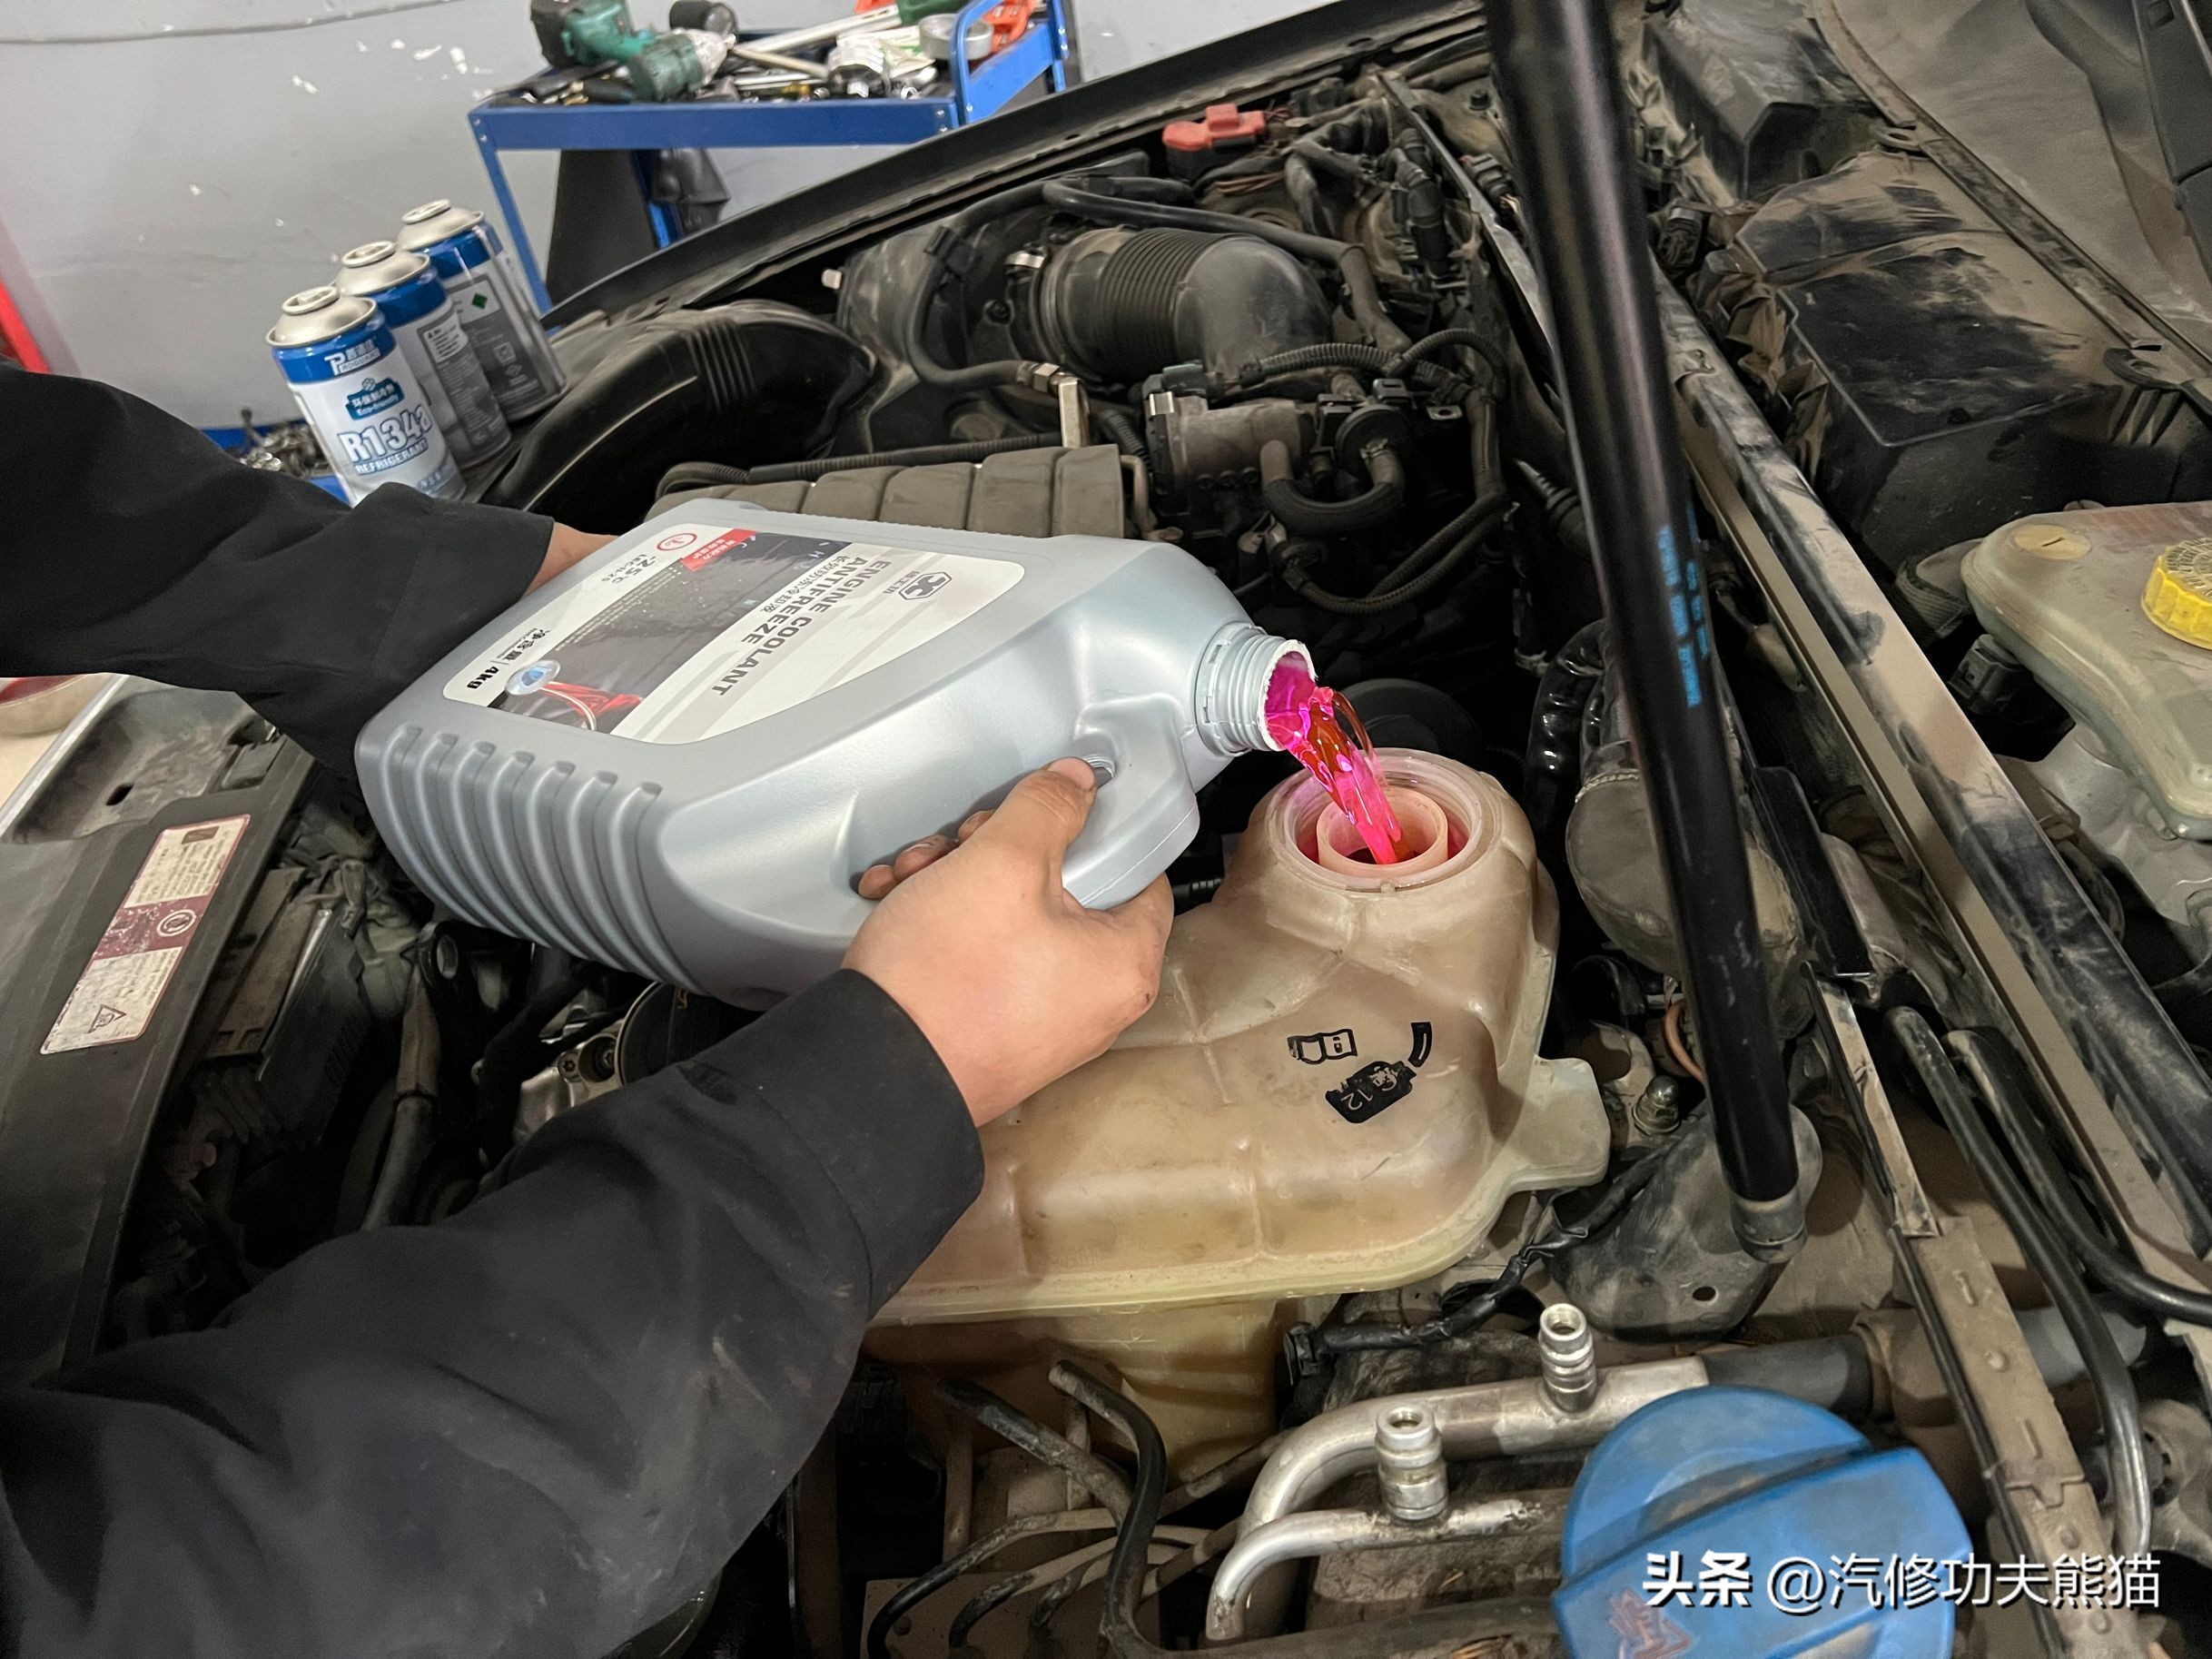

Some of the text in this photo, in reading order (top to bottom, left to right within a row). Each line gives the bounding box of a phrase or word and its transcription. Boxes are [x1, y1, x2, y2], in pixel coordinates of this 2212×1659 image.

[337, 404, 432, 463] R134a
[354, 438, 429, 475] REFRIGERANT
[741, 557, 868, 645] ANTIFREEZE
[760, 556, 850, 614] 长效防冻冷却液
[712, 560, 893, 696] ENGINE COOLANT
[467, 628, 551, 689] 净含量 4kg
